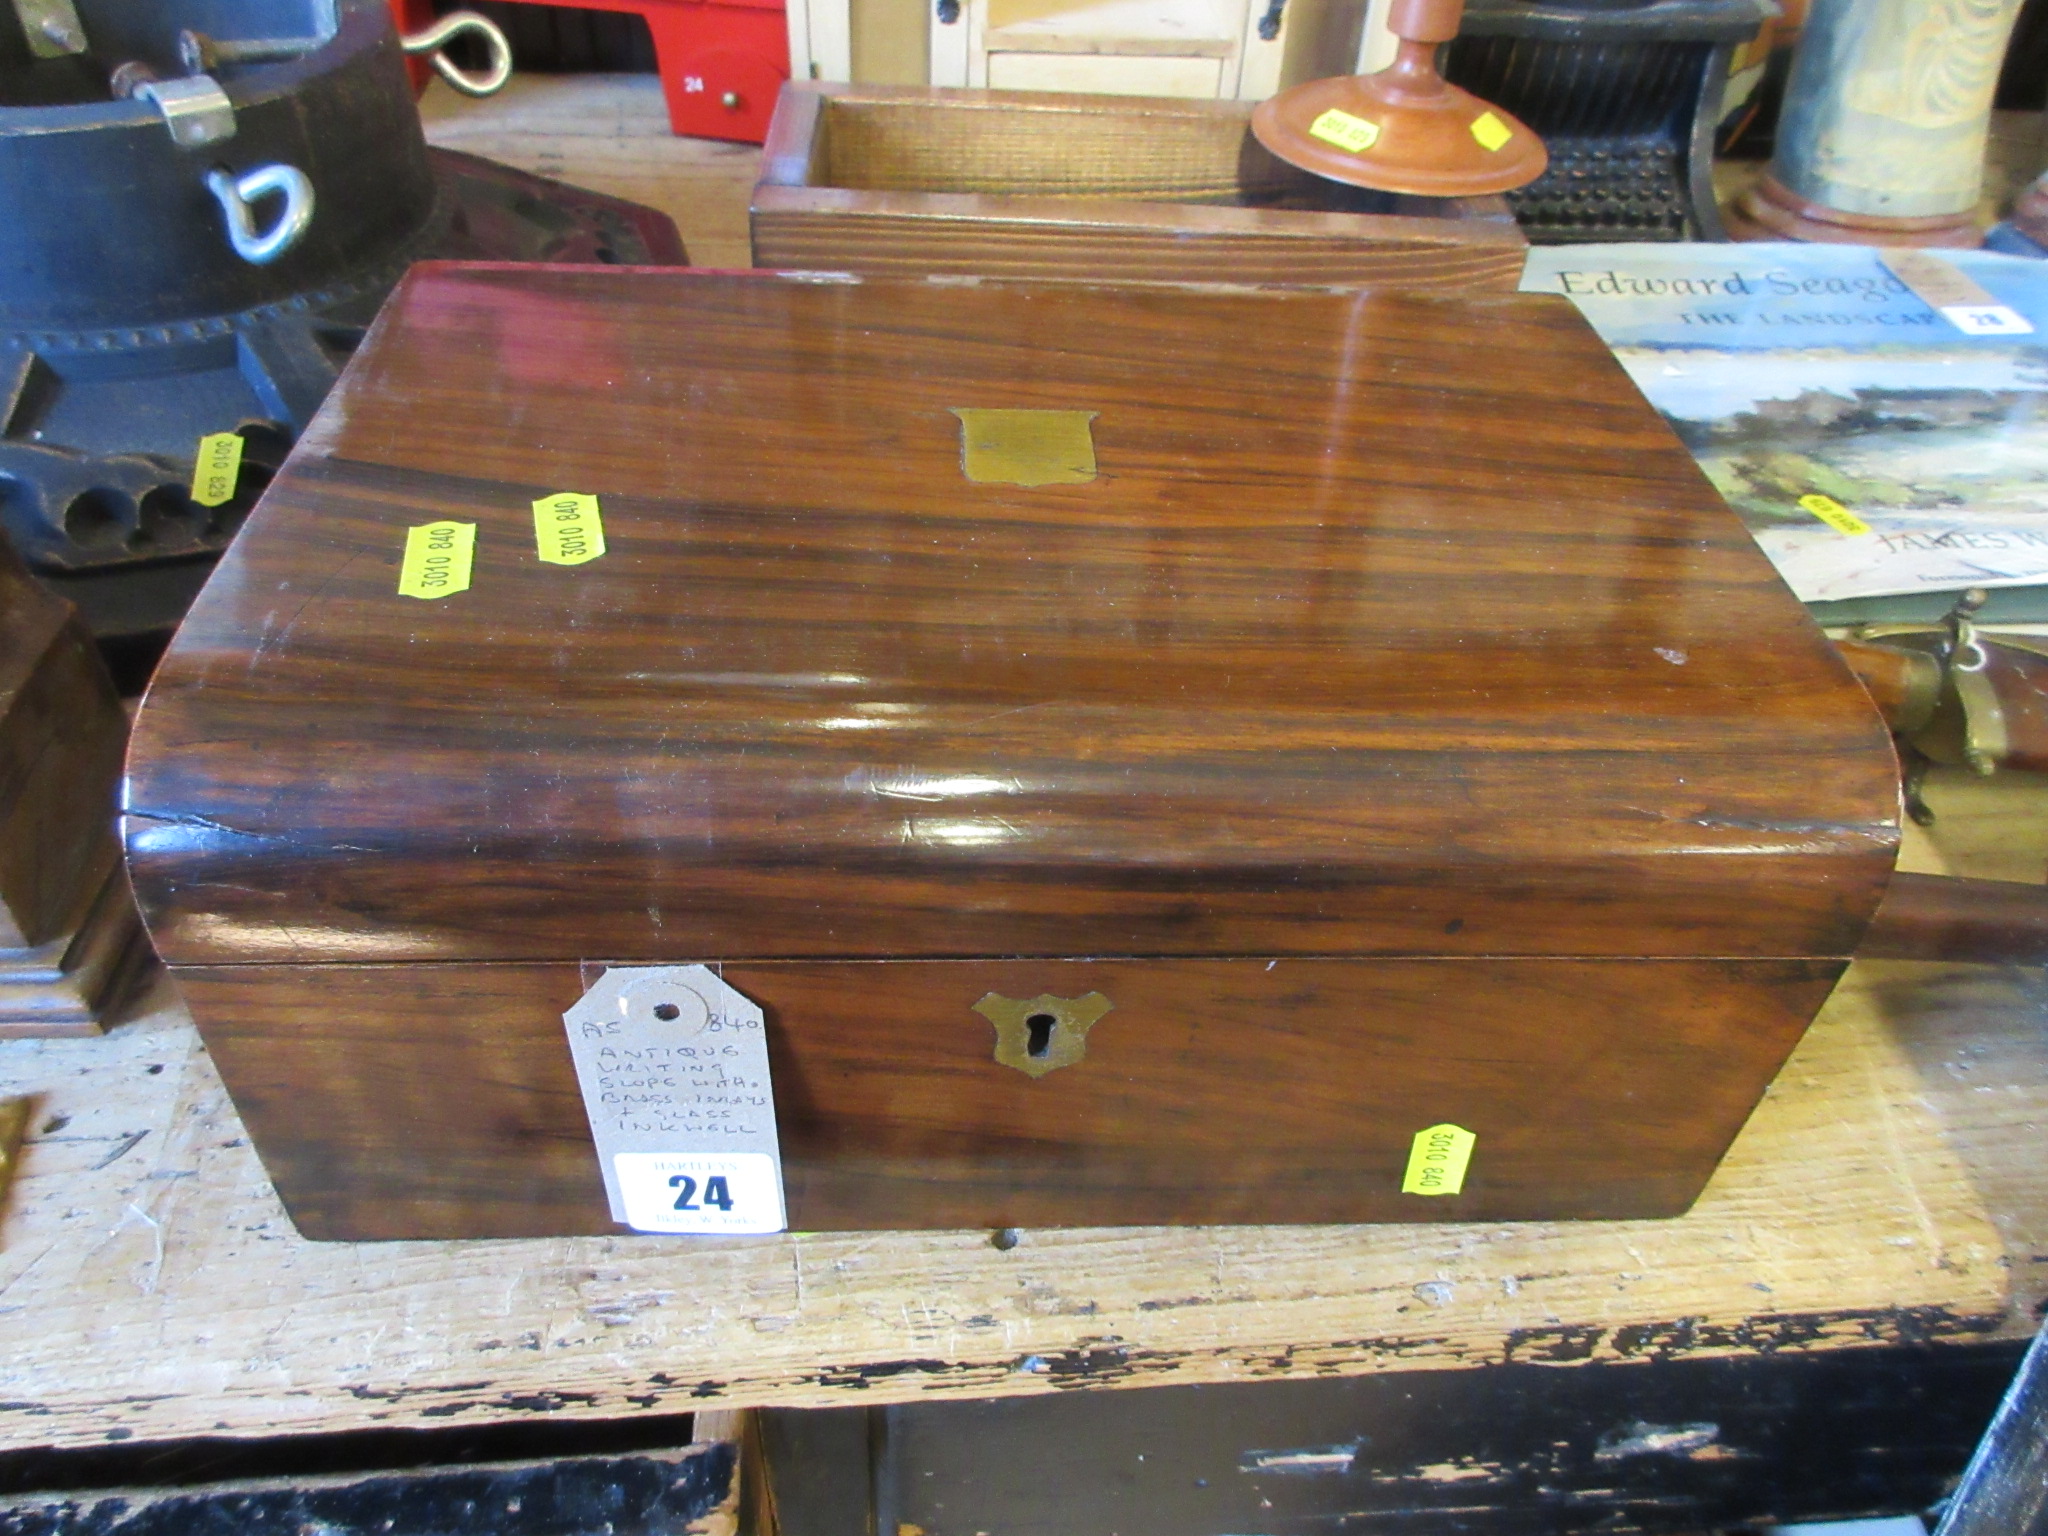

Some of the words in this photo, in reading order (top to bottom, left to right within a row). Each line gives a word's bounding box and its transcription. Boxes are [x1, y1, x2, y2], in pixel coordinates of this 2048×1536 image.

[684, 76, 705, 92] 24
[1555, 270, 1753, 295] Edward
[1680, 312, 1743, 325] THE
[1759, 312, 1935, 326] LANDSCAP
[554, 500, 581, 522] 840
[428, 528, 456, 550] 840
[558, 526, 587, 557] 3010
[1877, 530, 2010, 553] JAMES
[421, 556, 452, 588] 3010
[600, 1045, 739, 1060] ANTIQUE
[597, 1062, 724, 1079] WRITING
[600, 1077, 676, 1089] SLOPE
[601, 1092, 673, 1105] BRASS
[654, 1109, 732, 1121] GLASS
[619, 1121, 757, 1134] INKWELL
[1425, 1133, 1455, 1160] 3010
[654, 1161, 738, 1171] HARTLEYS
[1419, 1167, 1445, 1187] 840
[668, 1174, 735, 1212] 24
